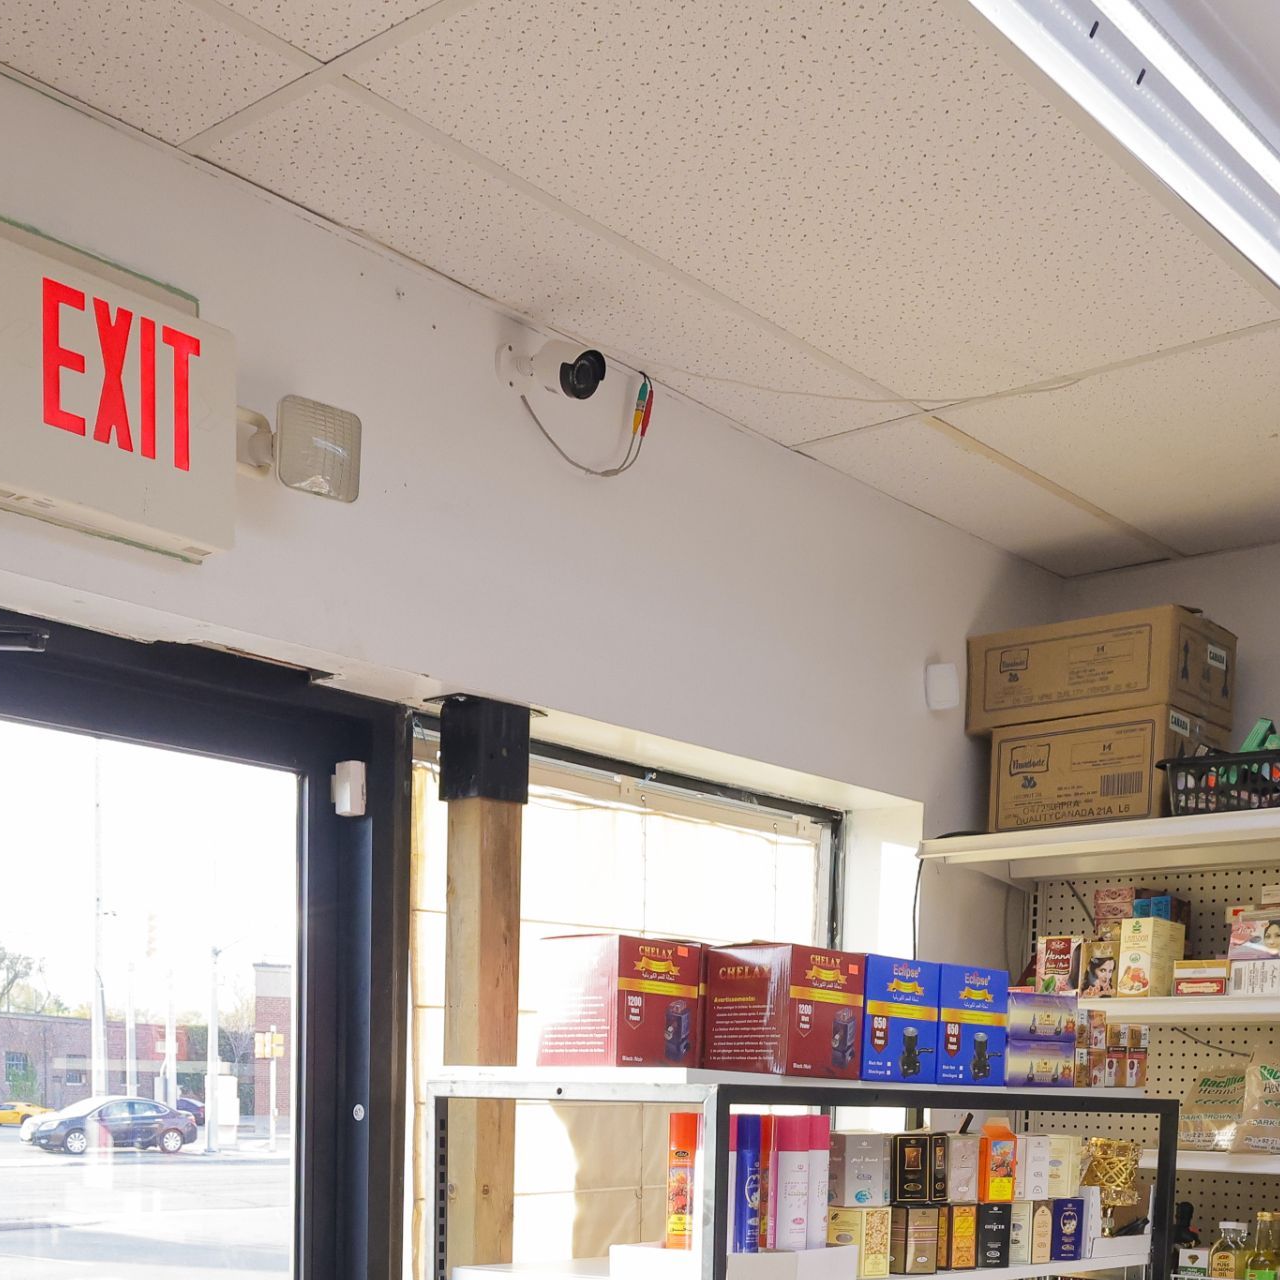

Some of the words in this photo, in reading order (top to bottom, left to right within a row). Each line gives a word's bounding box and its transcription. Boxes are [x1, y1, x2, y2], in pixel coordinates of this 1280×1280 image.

[41, 276, 200, 471] EXIT
[1209, 650, 1226, 664] CANADA
[1171, 715, 1188, 731] CANADA
[639, 945, 673, 959] CHELAX
[1046, 951, 1070, 961] Henna
[810, 954, 841, 968] CHELAX
[719, 965, 770, 979] CHELAX
[893, 963, 919, 978] Eclipse
[964, 972, 989, 986] Eclipse
[627, 996, 642, 1007] 1200
[798, 1004, 812, 1015] 1200
[873, 1017, 887, 1029] 650
[946, 1023, 959, 1035] 650
